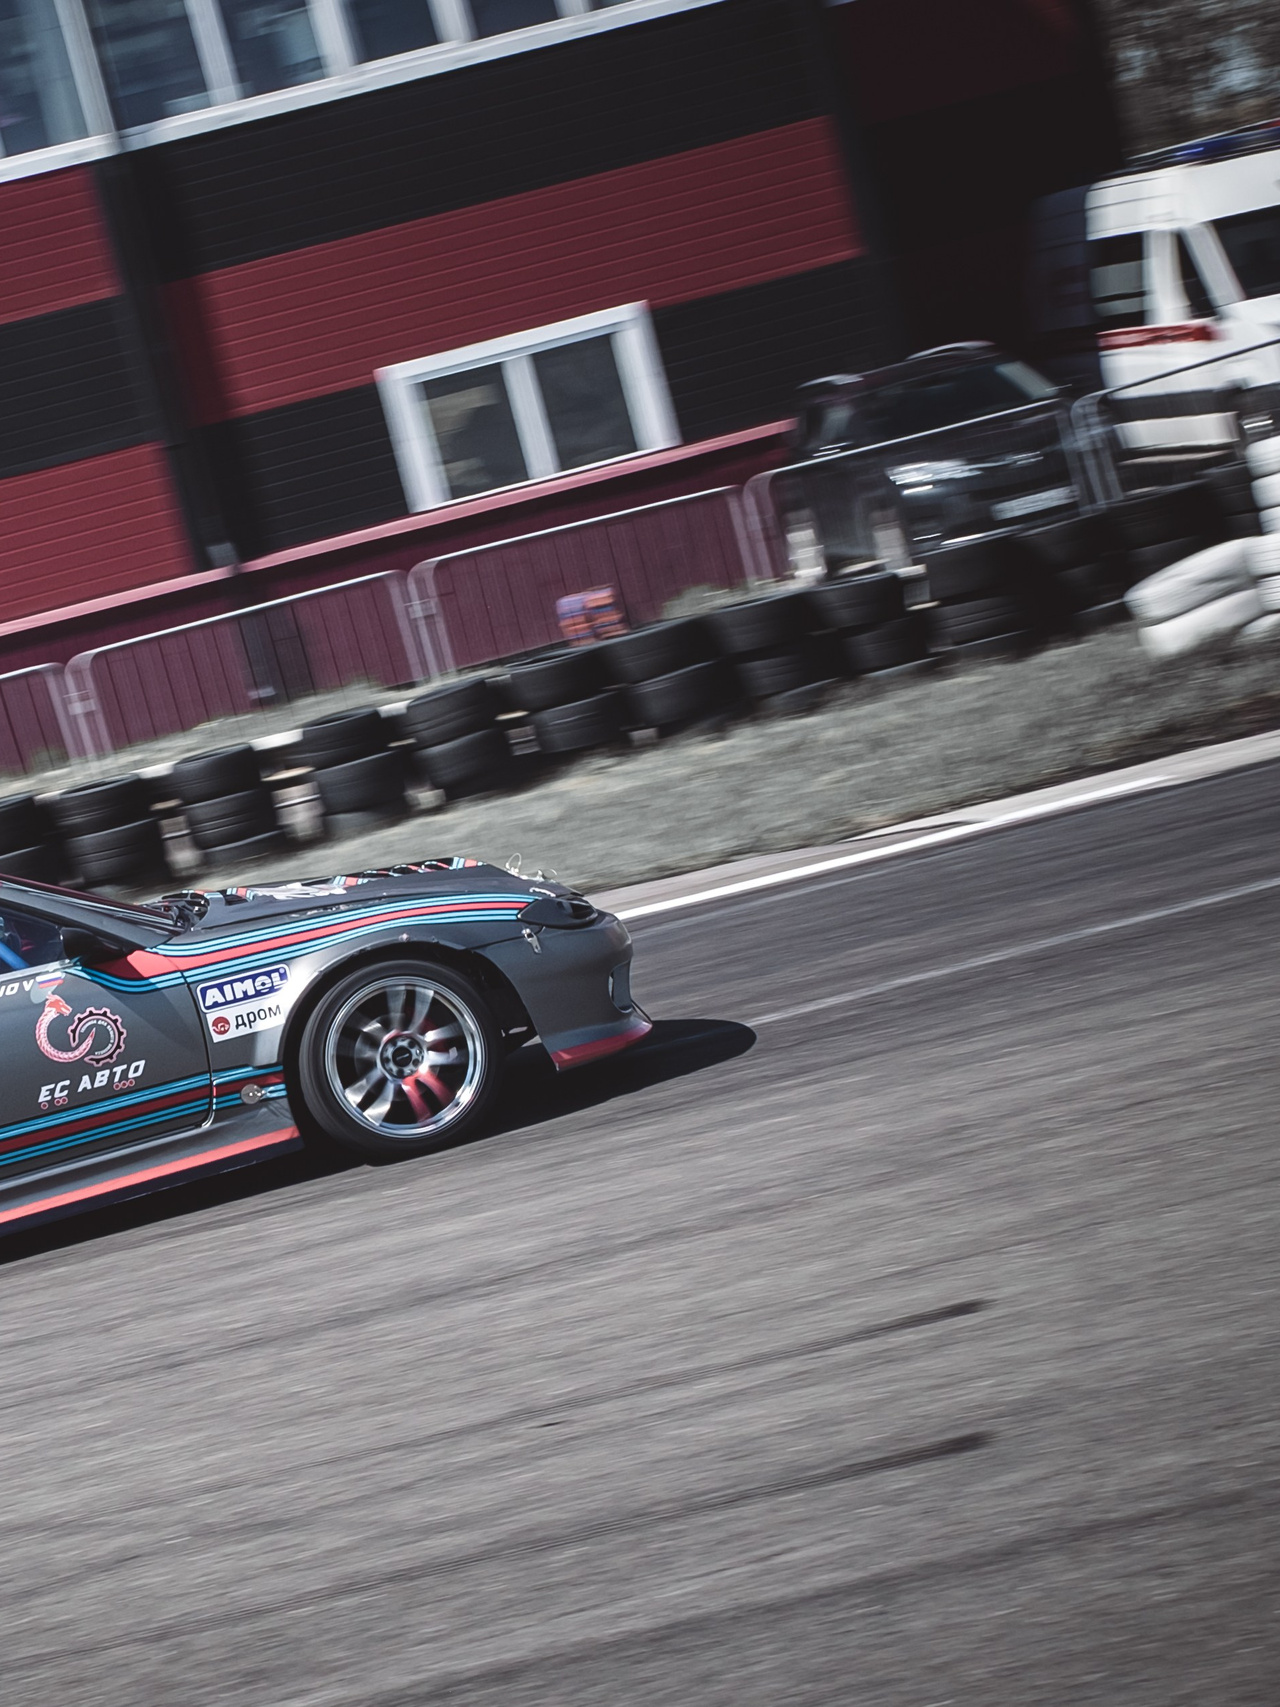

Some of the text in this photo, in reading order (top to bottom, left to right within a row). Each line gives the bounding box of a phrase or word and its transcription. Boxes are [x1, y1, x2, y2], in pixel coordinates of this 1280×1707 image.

[205, 972, 287, 1006] AIMOL
[235, 1005, 282, 1030] дром
[77, 1060, 145, 1092] АВТО
